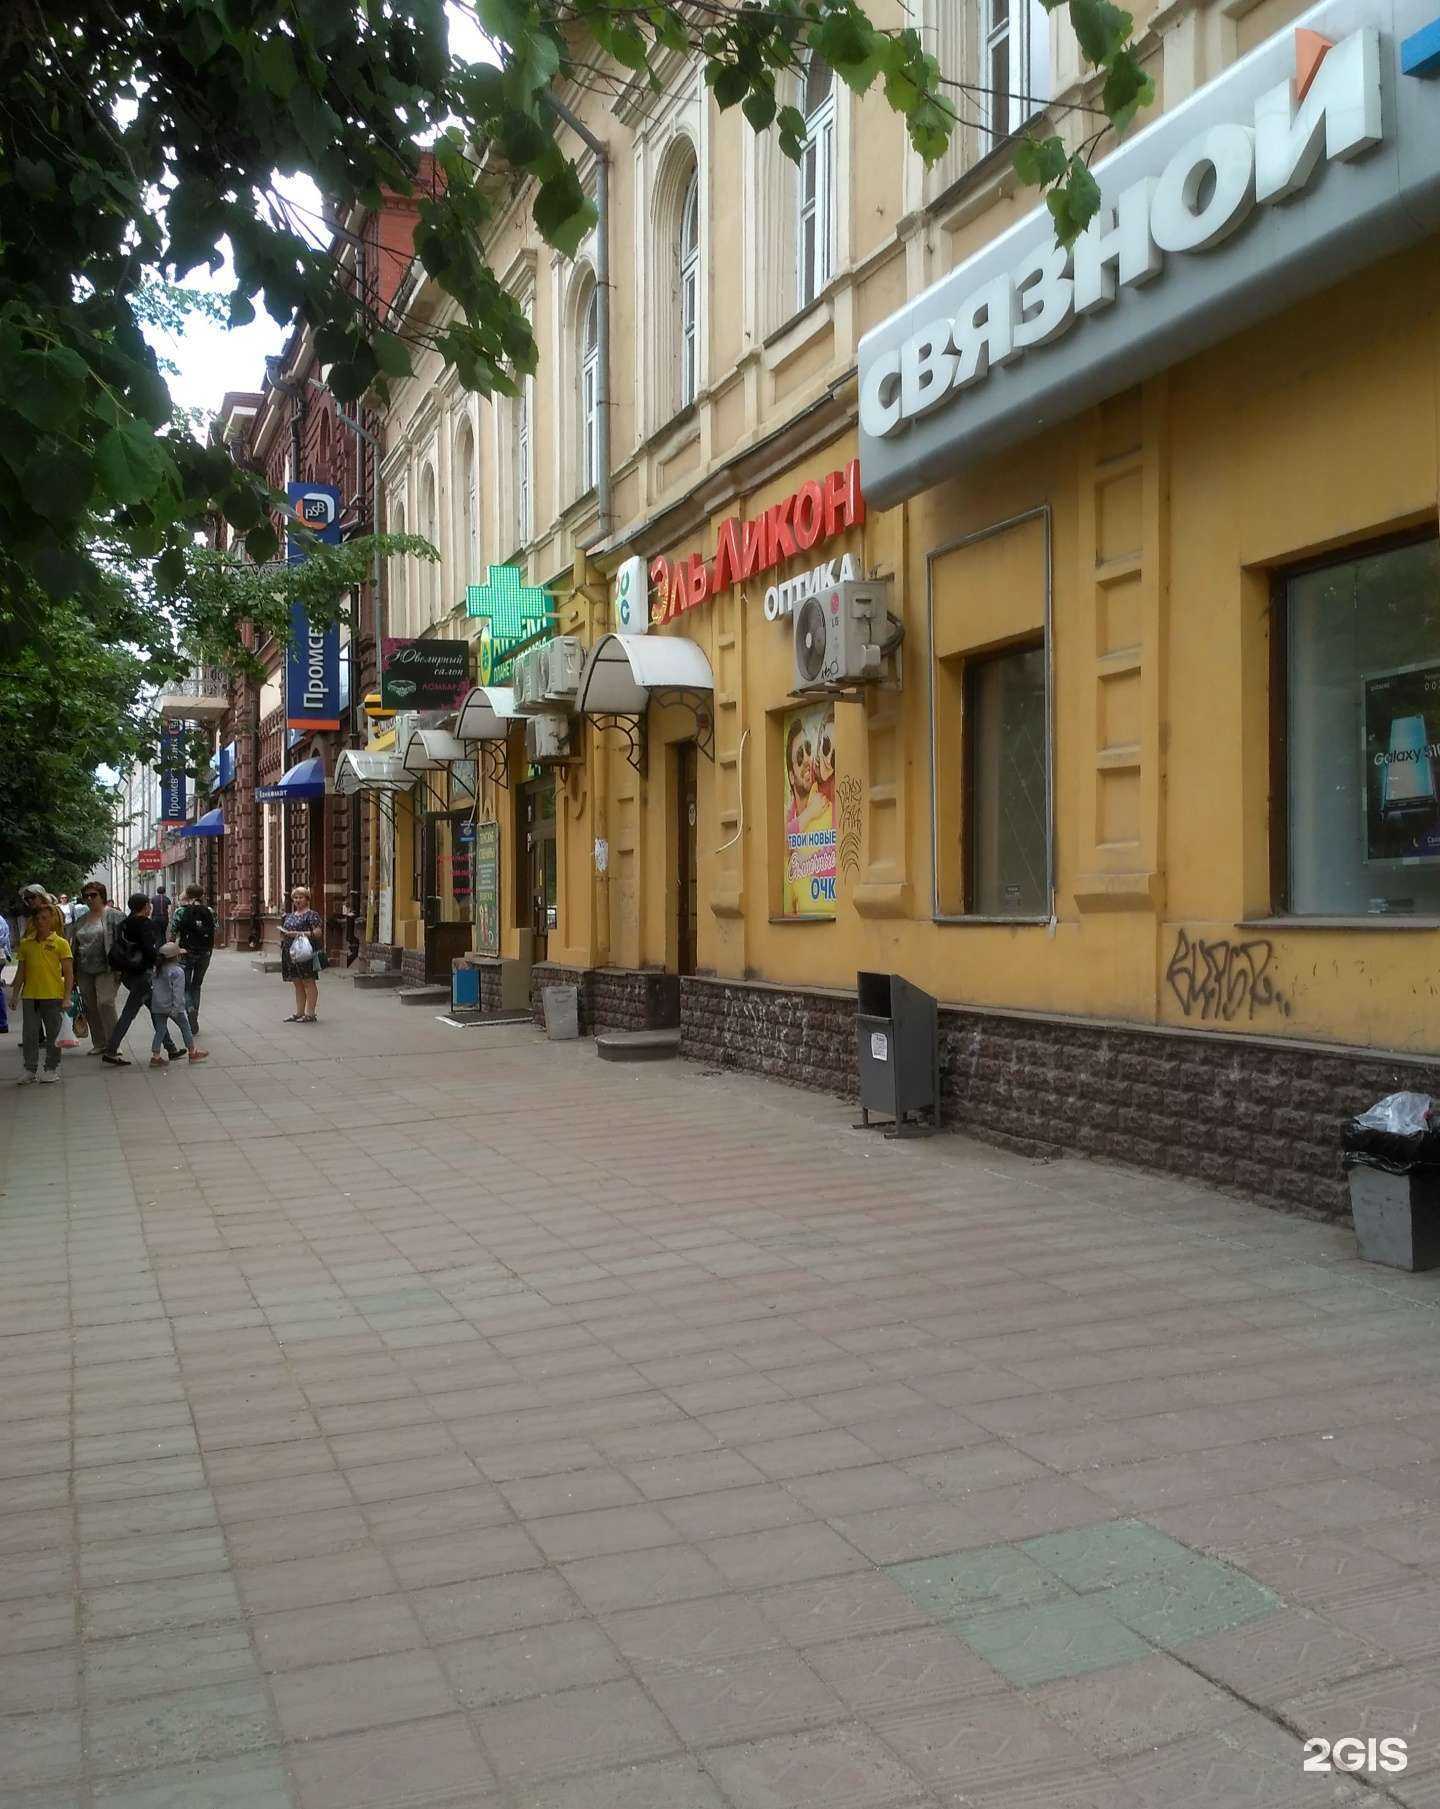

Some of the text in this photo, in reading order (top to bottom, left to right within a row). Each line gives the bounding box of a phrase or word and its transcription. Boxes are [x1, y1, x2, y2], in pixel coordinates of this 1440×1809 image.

[862, 23, 1382, 438] СВЯЗНОЙ
[764, 552, 854, 621] ОПТИКА
[1374, 749, 1422, 766] Galaxy
